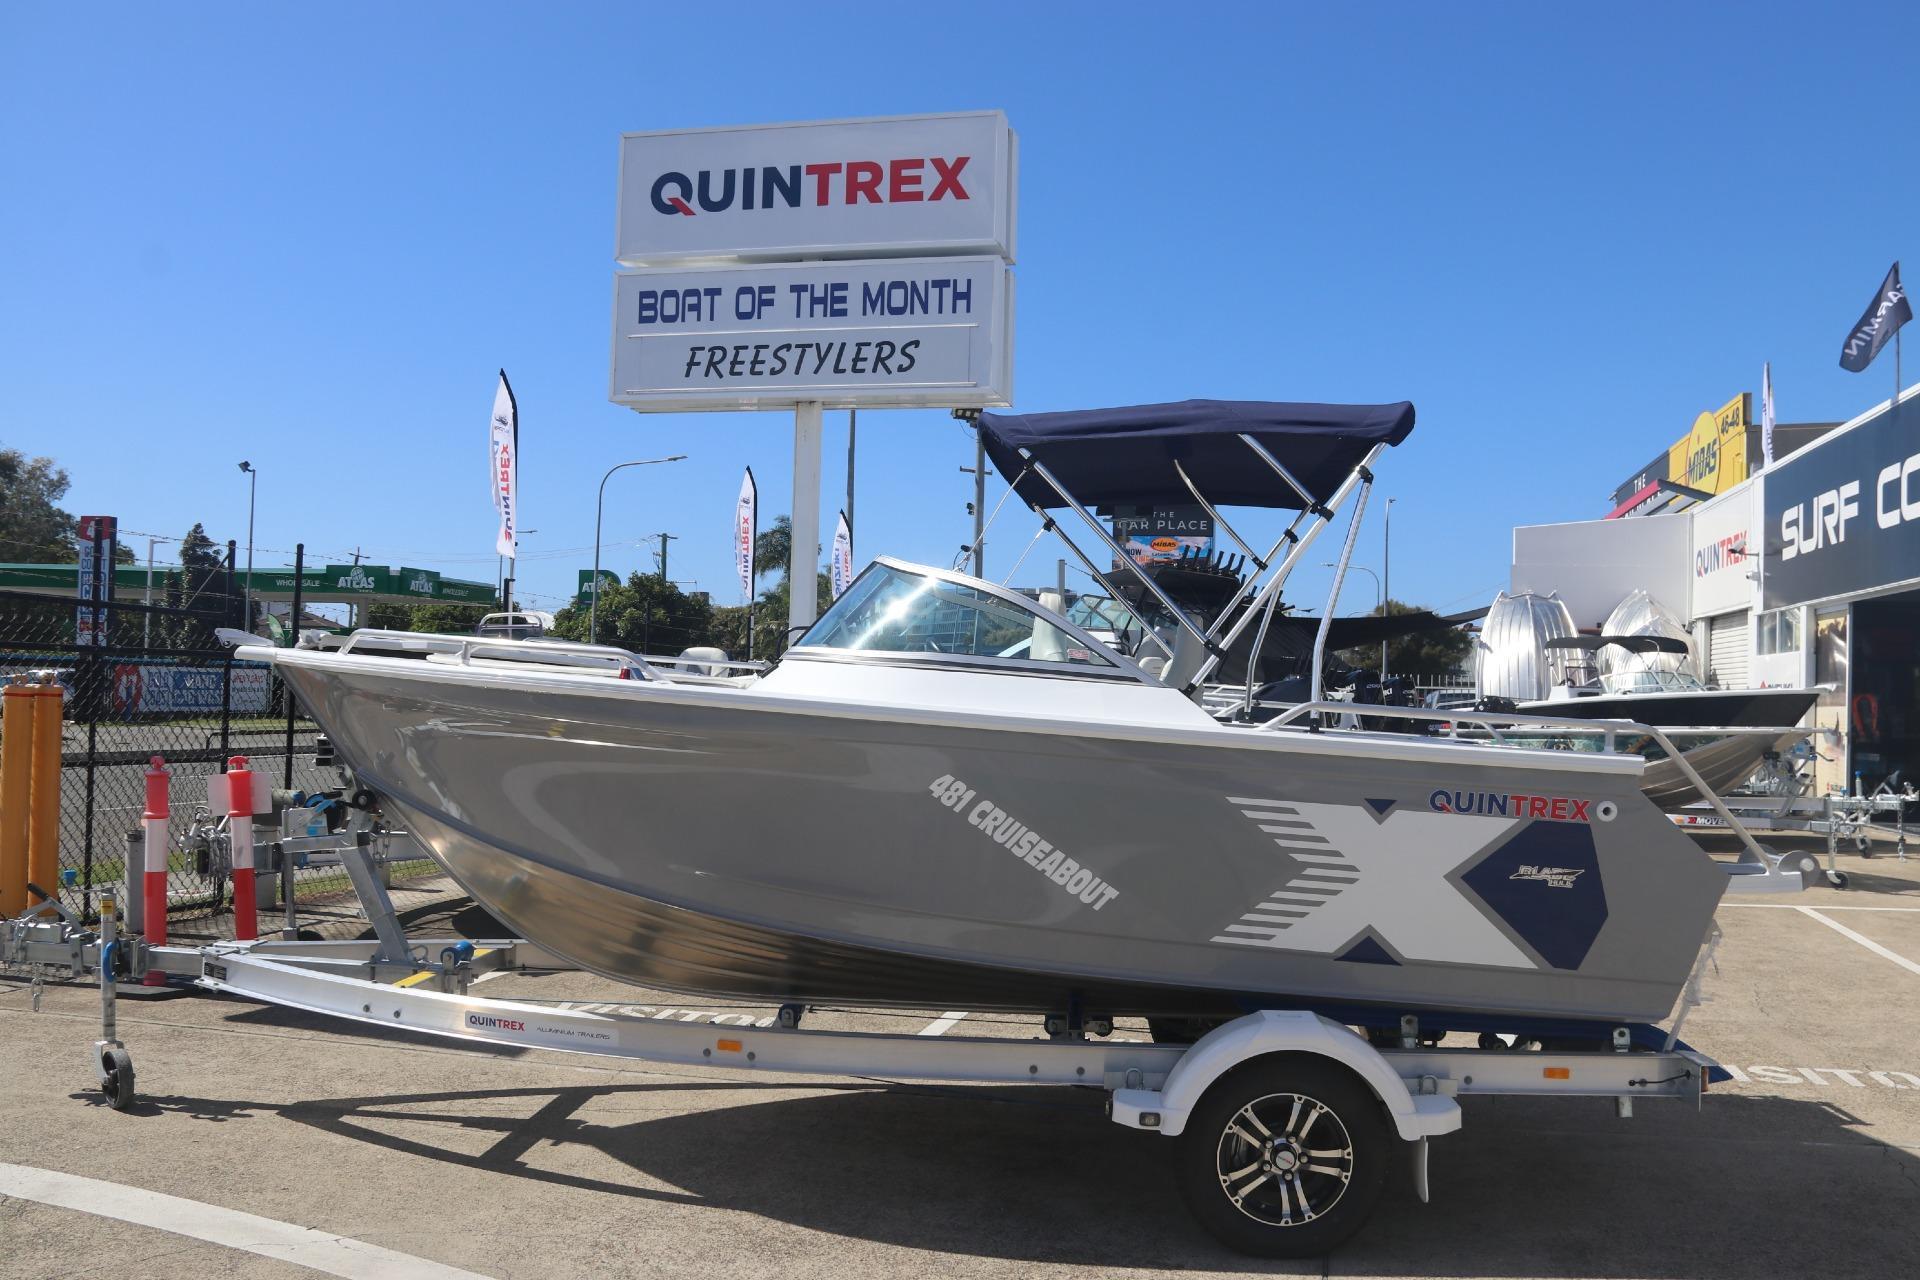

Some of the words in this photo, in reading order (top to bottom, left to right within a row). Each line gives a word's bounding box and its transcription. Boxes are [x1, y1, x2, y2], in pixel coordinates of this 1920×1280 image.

[650, 156, 971, 217] QUINTREX
[637, 287, 722, 324] BOAT
[734, 285, 776, 321] OF
[789, 282, 849, 319] THE
[861, 278, 973, 317] MONTH
[684, 339, 921, 380] FREESTYLERS
[1720, 406, 1740, 437] 46-48
[1688, 438, 1718, 486] MIDAS
[1117, 520, 1149, 531] CAR
[1157, 520, 1208, 530] PLACE
[1781, 479, 1860, 562] SURF
[1696, 530, 1748, 578] QUINTREX
[275, 579, 321, 587] WHOLSALE
[337, 576, 375, 589] ATLAS
[928, 773, 977, 813] 481
[1429, 789, 1591, 823] QUINTREX
[1696, 817, 1725, 825] MOVE
[967, 800, 1120, 911] CRUISEABOUT
[469, 1014, 526, 1032] QUINTREX
[1721, 1064, 1920, 1089] ISITO
